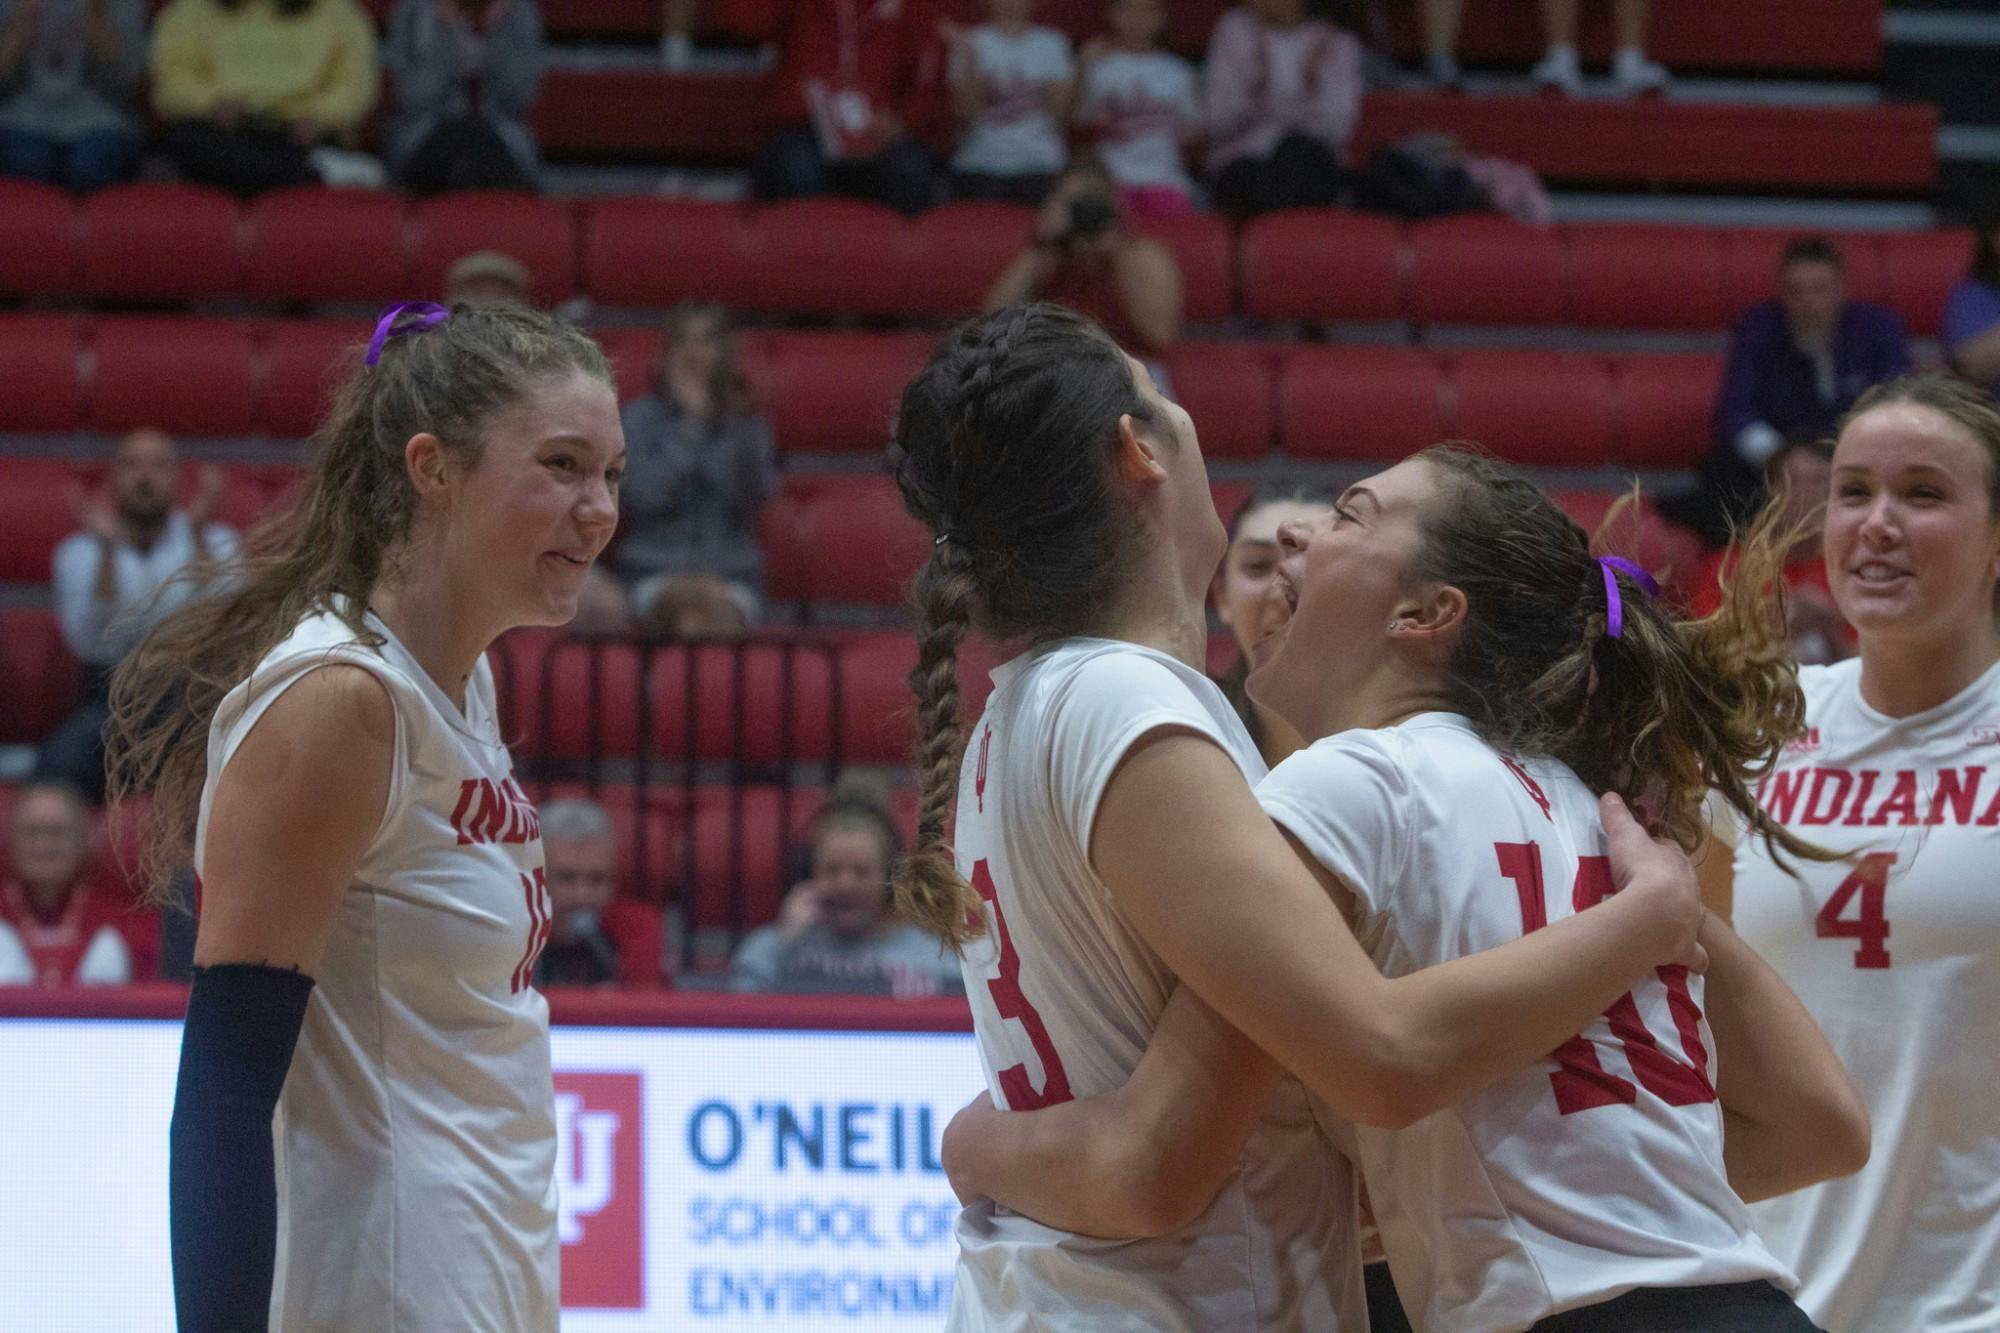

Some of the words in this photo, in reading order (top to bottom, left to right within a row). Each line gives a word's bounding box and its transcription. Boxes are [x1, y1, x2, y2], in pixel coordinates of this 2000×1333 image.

[1815, 852, 1897, 969] 4
[690, 1197, 884, 1246] SCHOOL
[902, 1199, 957, 1246] OF
[690, 1266, 956, 1317] ENVIRONM
